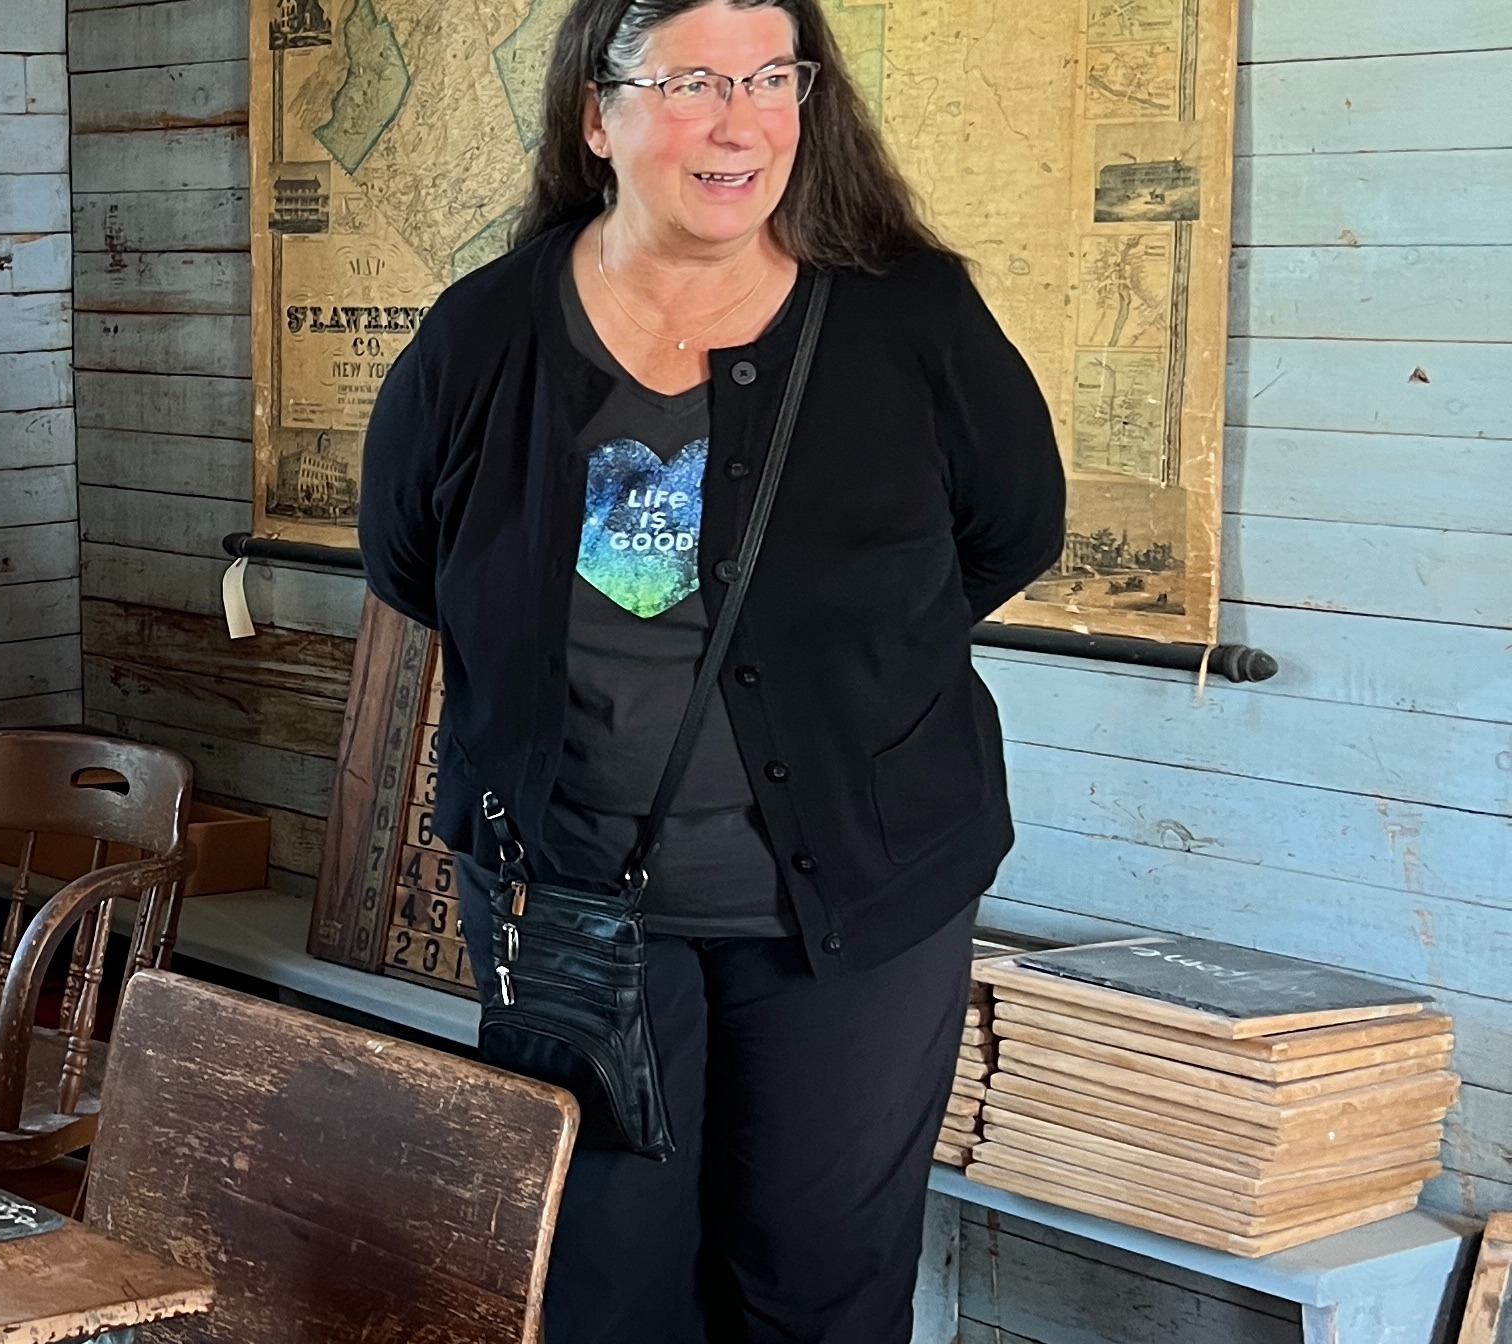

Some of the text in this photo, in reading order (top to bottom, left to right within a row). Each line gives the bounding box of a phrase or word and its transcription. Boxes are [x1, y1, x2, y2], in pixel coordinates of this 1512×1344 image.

[352, 337, 384, 357] CO.
[333, 362, 361, 378] NEW
[640, 511, 666, 529] IS
[609, 532, 694, 551] GOOD
[418, 812, 434, 846] 6
[370, 844, 385, 872] 7
[363, 886, 377, 911] 8
